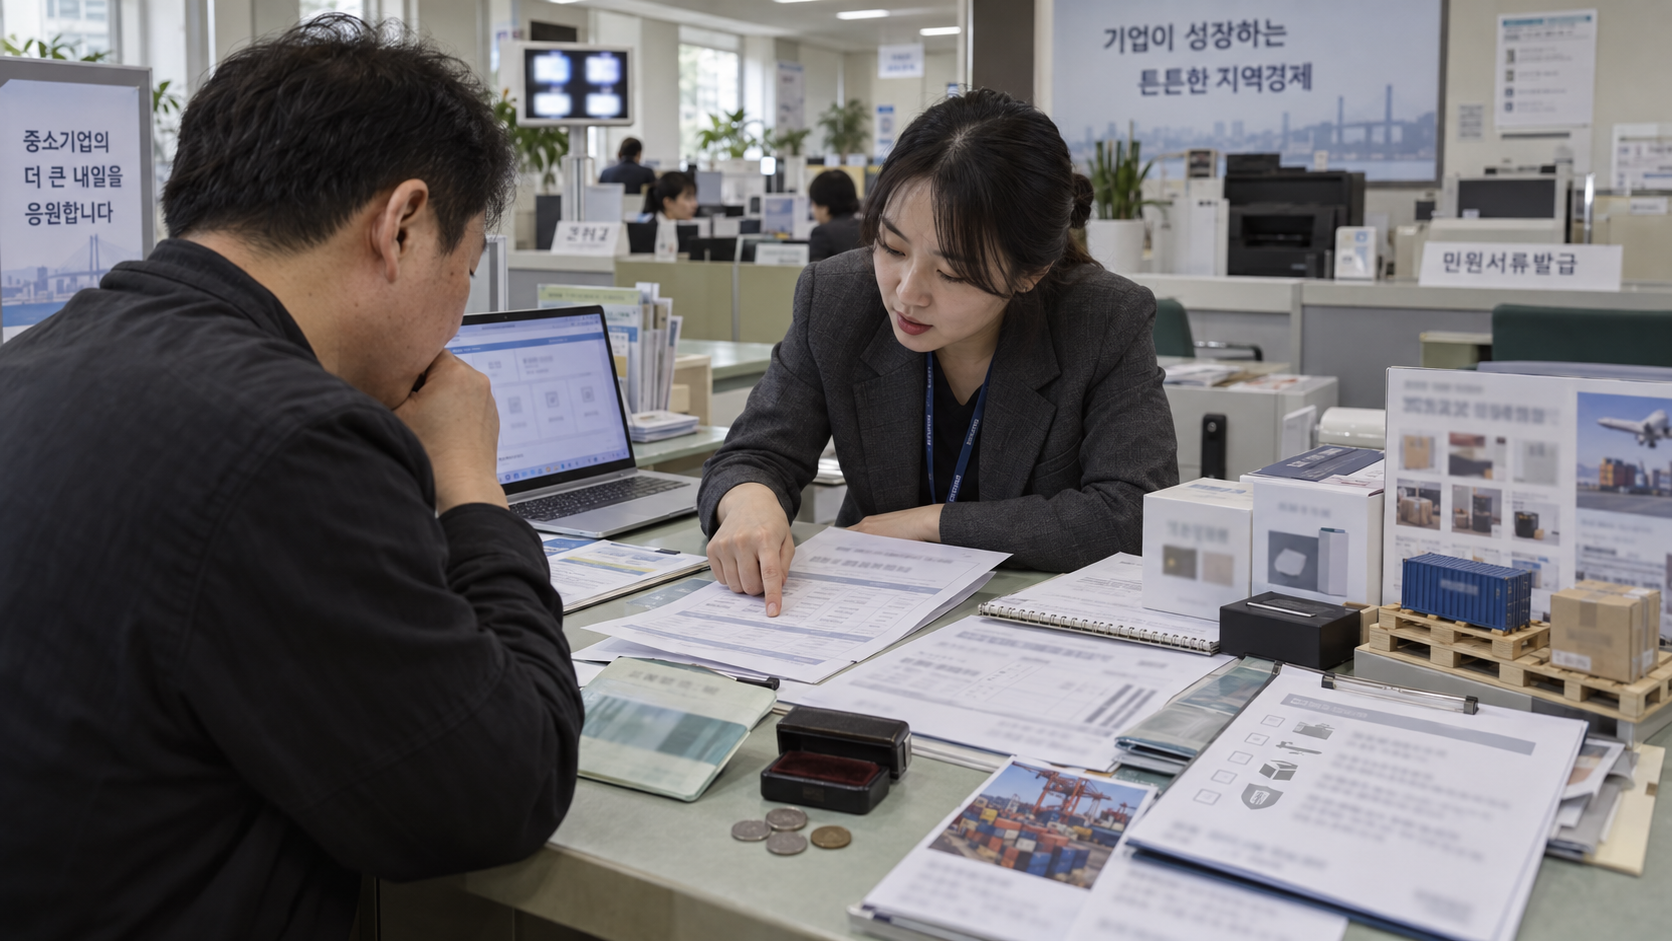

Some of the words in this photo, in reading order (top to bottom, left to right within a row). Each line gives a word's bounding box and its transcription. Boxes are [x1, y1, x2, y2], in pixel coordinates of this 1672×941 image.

[1104, 23, 1174, 54] 기업이
[1185, 18, 1287, 51] 성장하는
[1138, 66, 1209, 96] 튼튼한
[1216, 62, 1313, 94] 지역경제
[23, 130, 109, 153] 중소기업의
[24, 165, 41, 189] 더
[48, 166, 66, 188] 큰
[73, 165, 123, 188] 내일을
[25, 201, 114, 226] 응원합니다
[1443, 251, 1578, 276] 민원서류발급
